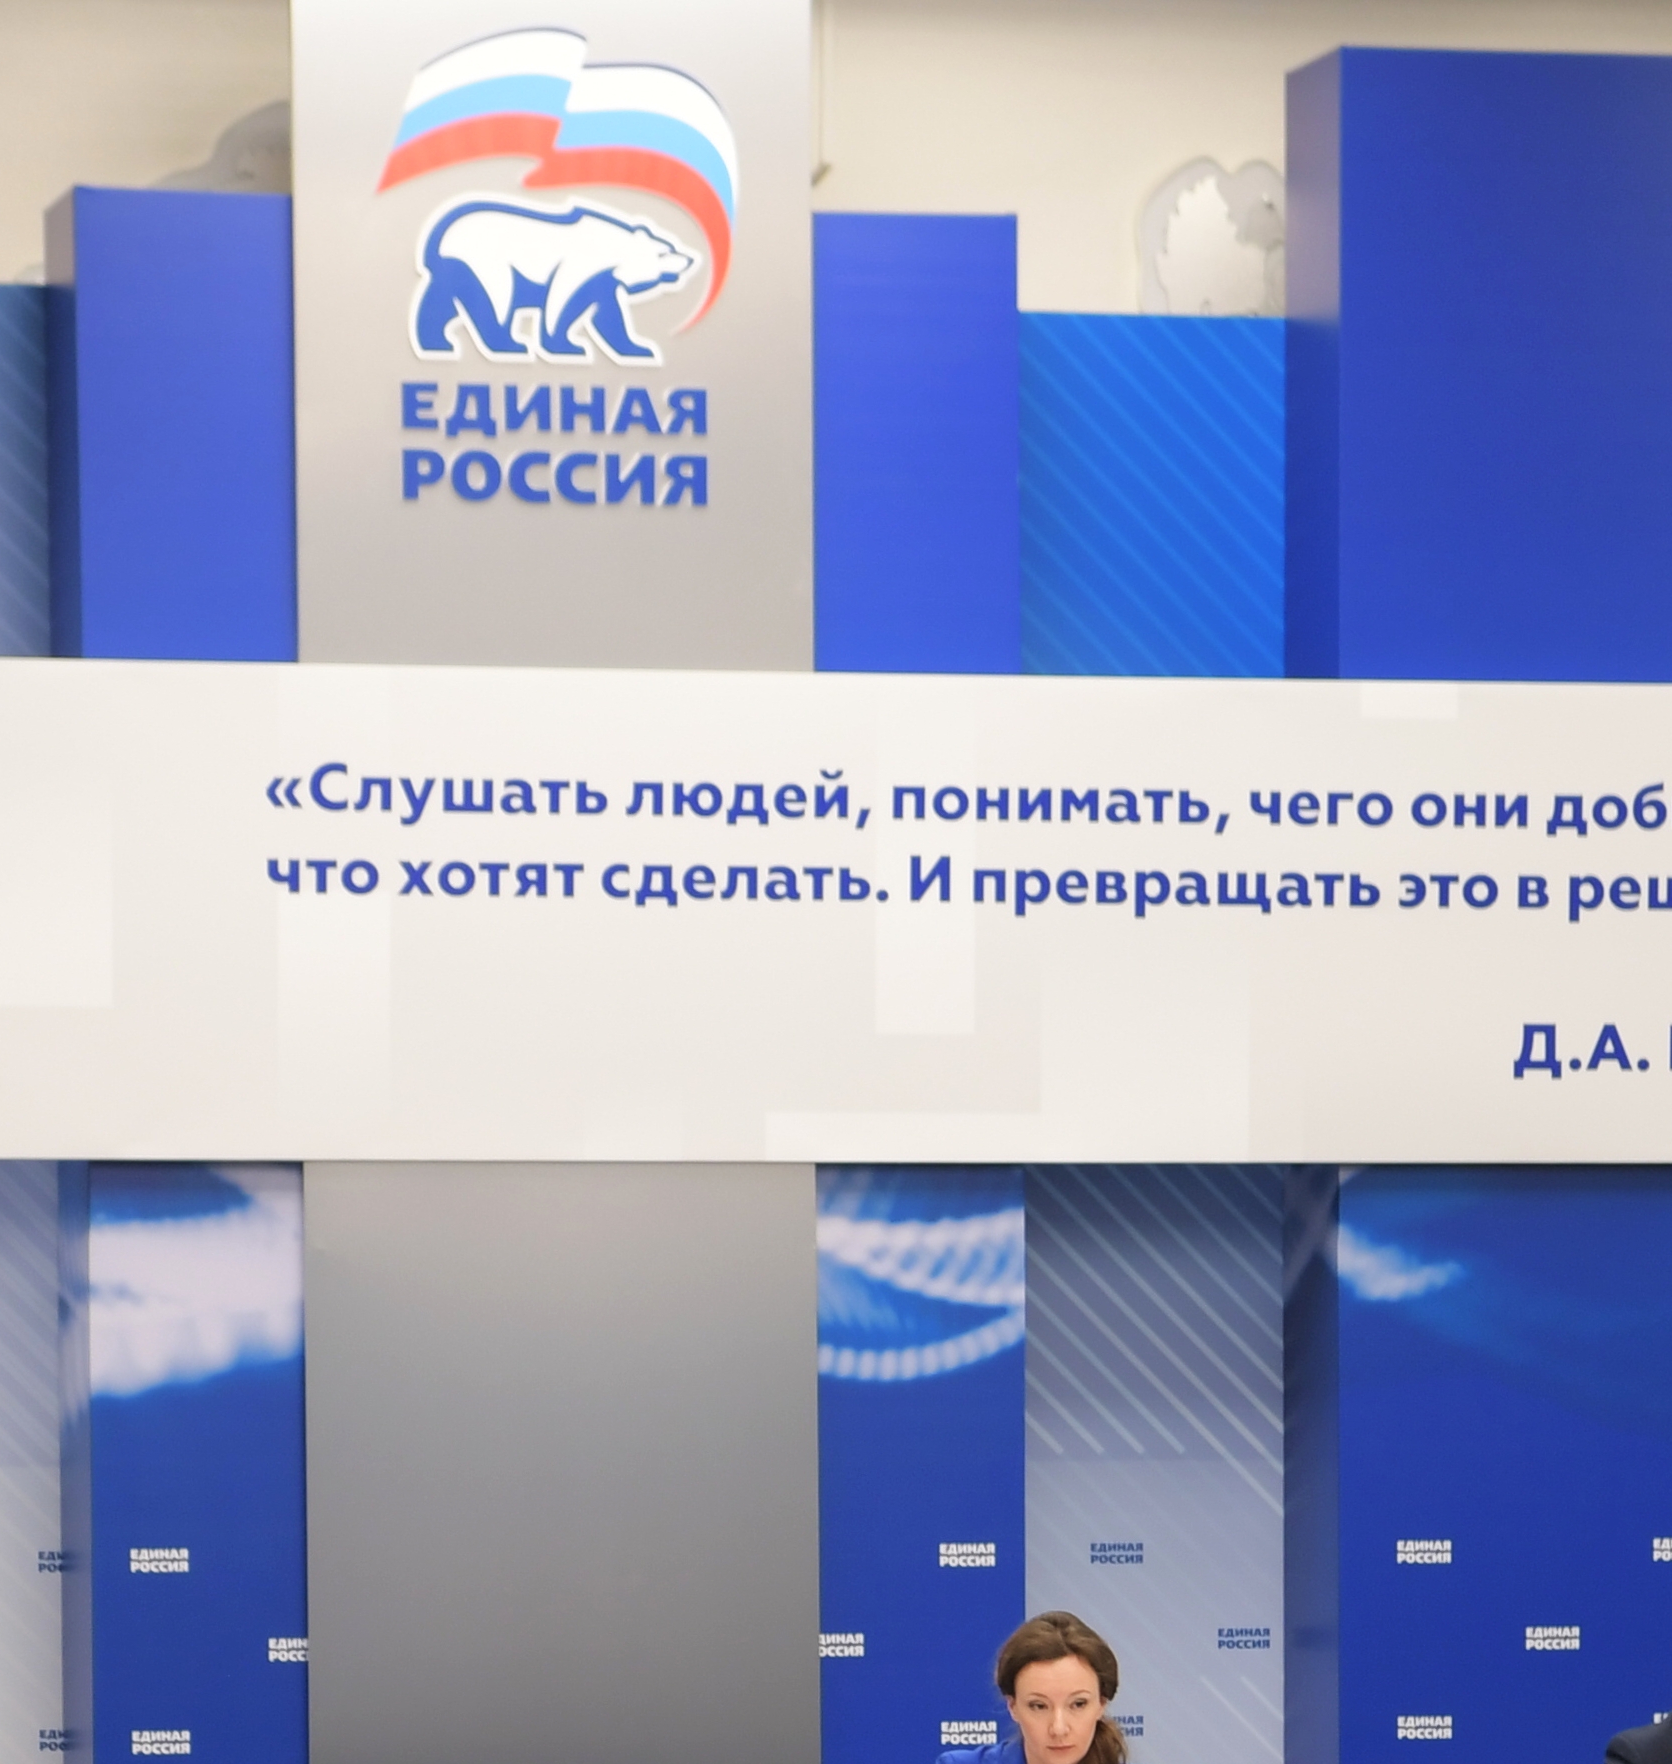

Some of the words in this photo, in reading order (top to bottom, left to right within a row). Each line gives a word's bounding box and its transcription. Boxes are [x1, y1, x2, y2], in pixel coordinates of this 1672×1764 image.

[400, 381, 709, 438] ЕДИНАЯ
[401, 448, 709, 508] РОССИЯ
[265, 761, 609, 827] «Слушать
[626, 768, 870, 830] людей,
[892, 785, 1229, 835] понимать,
[1249, 789, 1393, 828] чего
[1410, 791, 1530, 829] они
[266, 857, 380, 897] что
[400, 860, 584, 898] хотят
[600, 862, 890, 908] сделать.
[908, 855, 952, 903] И
[972, 867, 1381, 919] превращать
[1398, 872, 1499, 910] это
[1517, 875, 1550, 910] в
[1513, 1023, 1650, 1080] Д.А.
[938, 1543, 996, 1555] ЕДИНАЯ
[1090, 1542, 1144, 1554] ЕДИНАЯ
[1396, 1539, 1452, 1552] ЕДИНАЯ
[129, 1548, 189, 1561] ЕДИНАЯ
[939, 1554, 996, 1567] РОССИЯ
[1090, 1553, 1144, 1565] РОССИЯ
[1396, 1551, 1452, 1564] РОССИЯ
[130, 1560, 190, 1573] РОССИЯ
[818, 1633, 865, 1645] ДИНАЯ
[1217, 1627, 1271, 1639] ЕДИНАЯ
[1525, 1626, 1580, 1639] ЕДИНАЯ
[268, 1637, 308, 1650] ЕДИН
[1217, 1638, 1271, 1650] РОССИЯ
[1525, 1638, 1581, 1651] РОССИЯ
[268, 1649, 307, 1662] РОСС
[818, 1644, 865, 1658] ОССИЯ
[940, 1721, 998, 1733] ЕДИНАЯ
[1397, 1715, 1453, 1728] ЕДИНАЯ
[131, 1730, 191, 1743] ЕДИНАЯ
[940, 1732, 999, 1746] РОССИЯ
[1397, 1727, 1453, 1740] РОССИЯ
[131, 1742, 191, 1755] РОССИЯ
